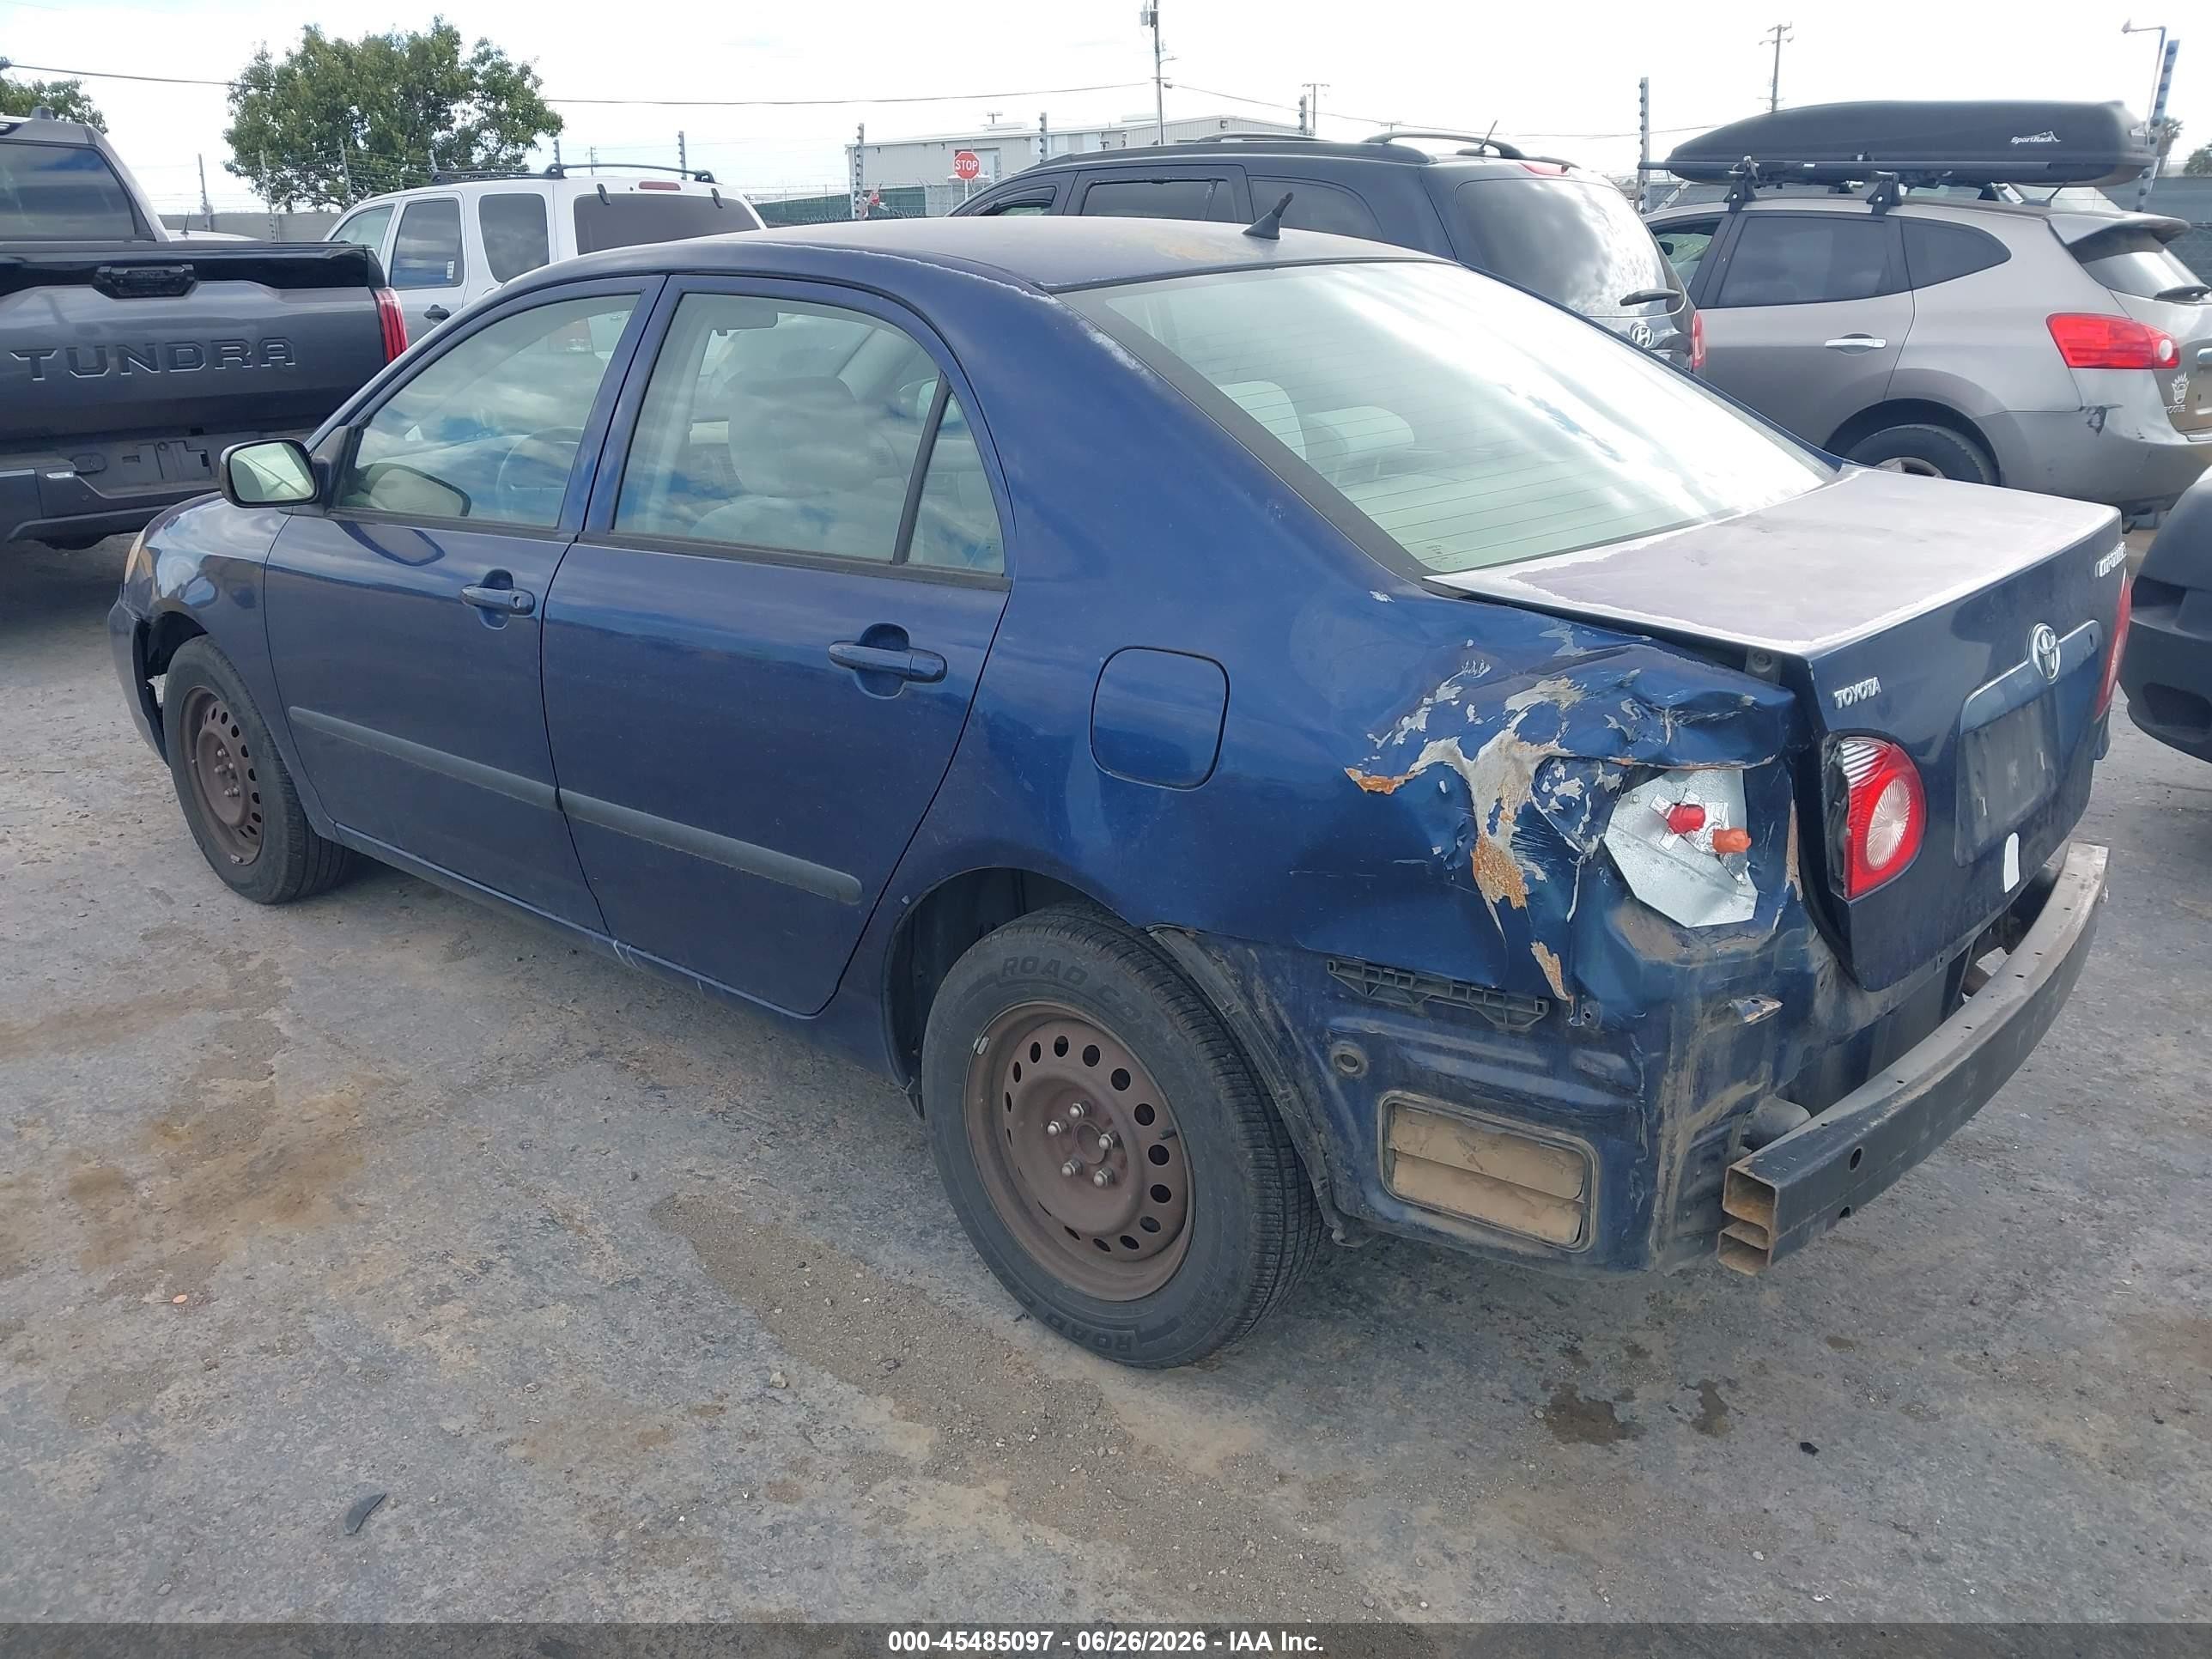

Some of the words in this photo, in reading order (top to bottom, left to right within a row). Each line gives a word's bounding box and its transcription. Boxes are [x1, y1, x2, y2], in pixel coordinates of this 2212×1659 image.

[2010, 135, 2054, 144] SportRack
[955, 159, 978, 171] STOP
[9, 337, 296, 380] TUNDRA
[1833, 677, 1882, 709] TOYOTA
[1001, 956, 1089, 986] ROAD
